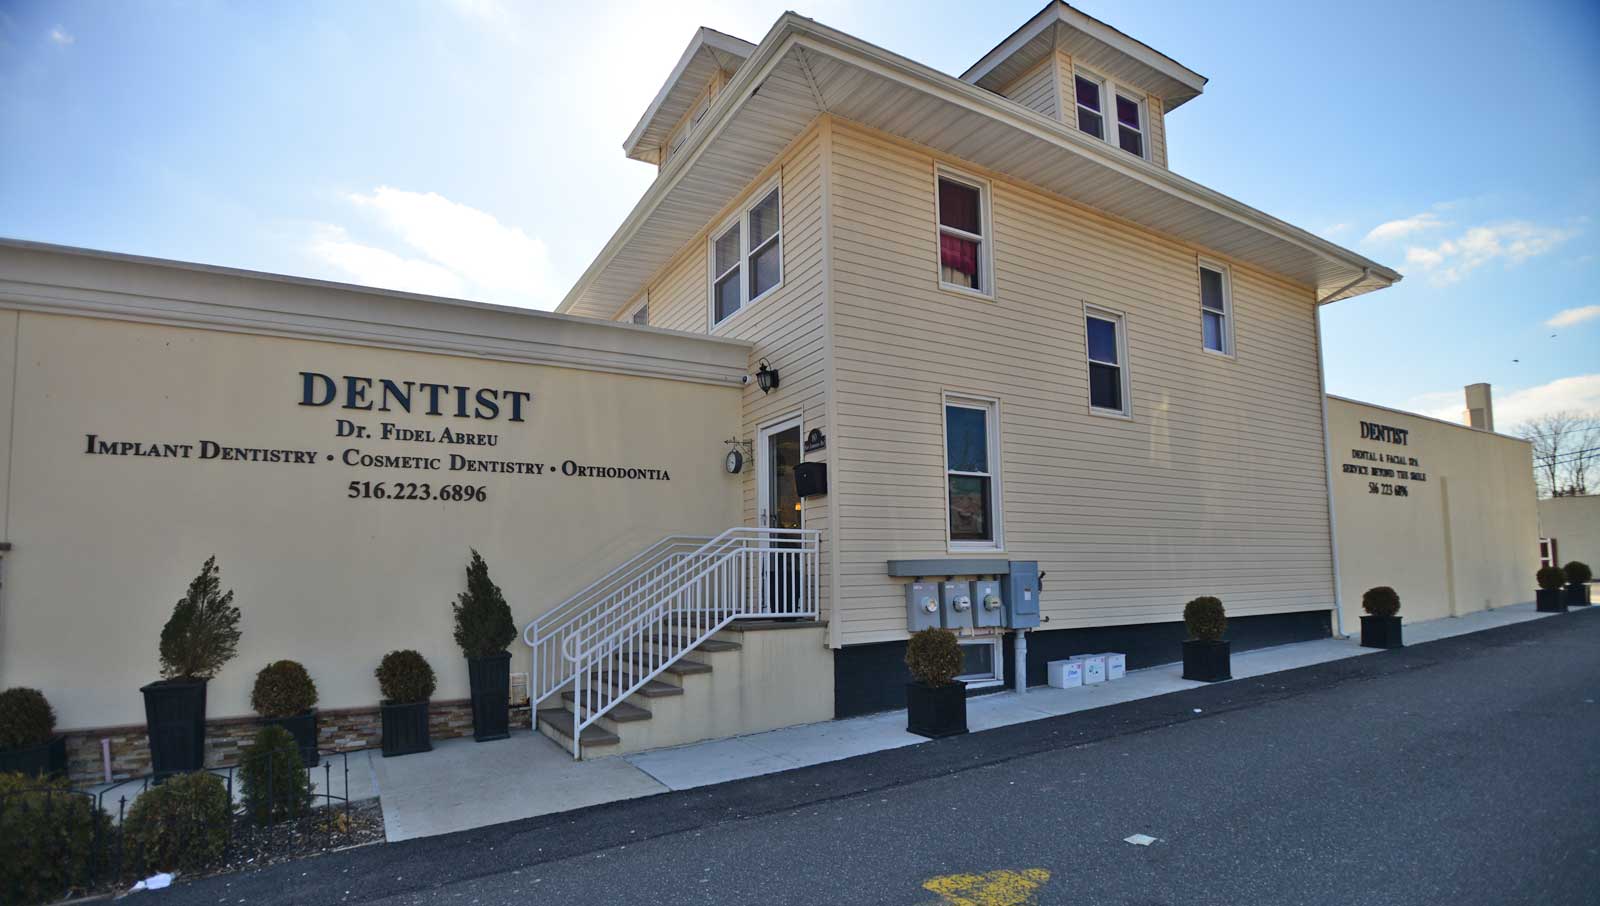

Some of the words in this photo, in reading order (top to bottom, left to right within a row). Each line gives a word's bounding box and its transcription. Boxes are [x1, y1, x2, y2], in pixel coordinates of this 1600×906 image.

[298, 371, 530, 422] DENTIST
[335, 419, 372, 439] Dr.
[380, 422, 435, 443] FIDEL
[438, 426, 499, 446] ABREU
[1359, 421, 1409, 446] DENTIST
[85, 434, 193, 458] IMPLANT
[198, 440, 318, 464] DENTISTRY
[342, 448, 441, 470] COSMETIC
[449, 453, 544, 475] DENTISTRY
[561, 460, 671, 481] ORTHODONTIA
[1351, 449, 1378, 462] DENTAL
[1386, 454, 1407, 465] FACIAL
[1342, 464, 1369, 475] SERVICE
[1396, 470, 1409, 480] THE
[347, 480, 488, 502] 516.223.6896
